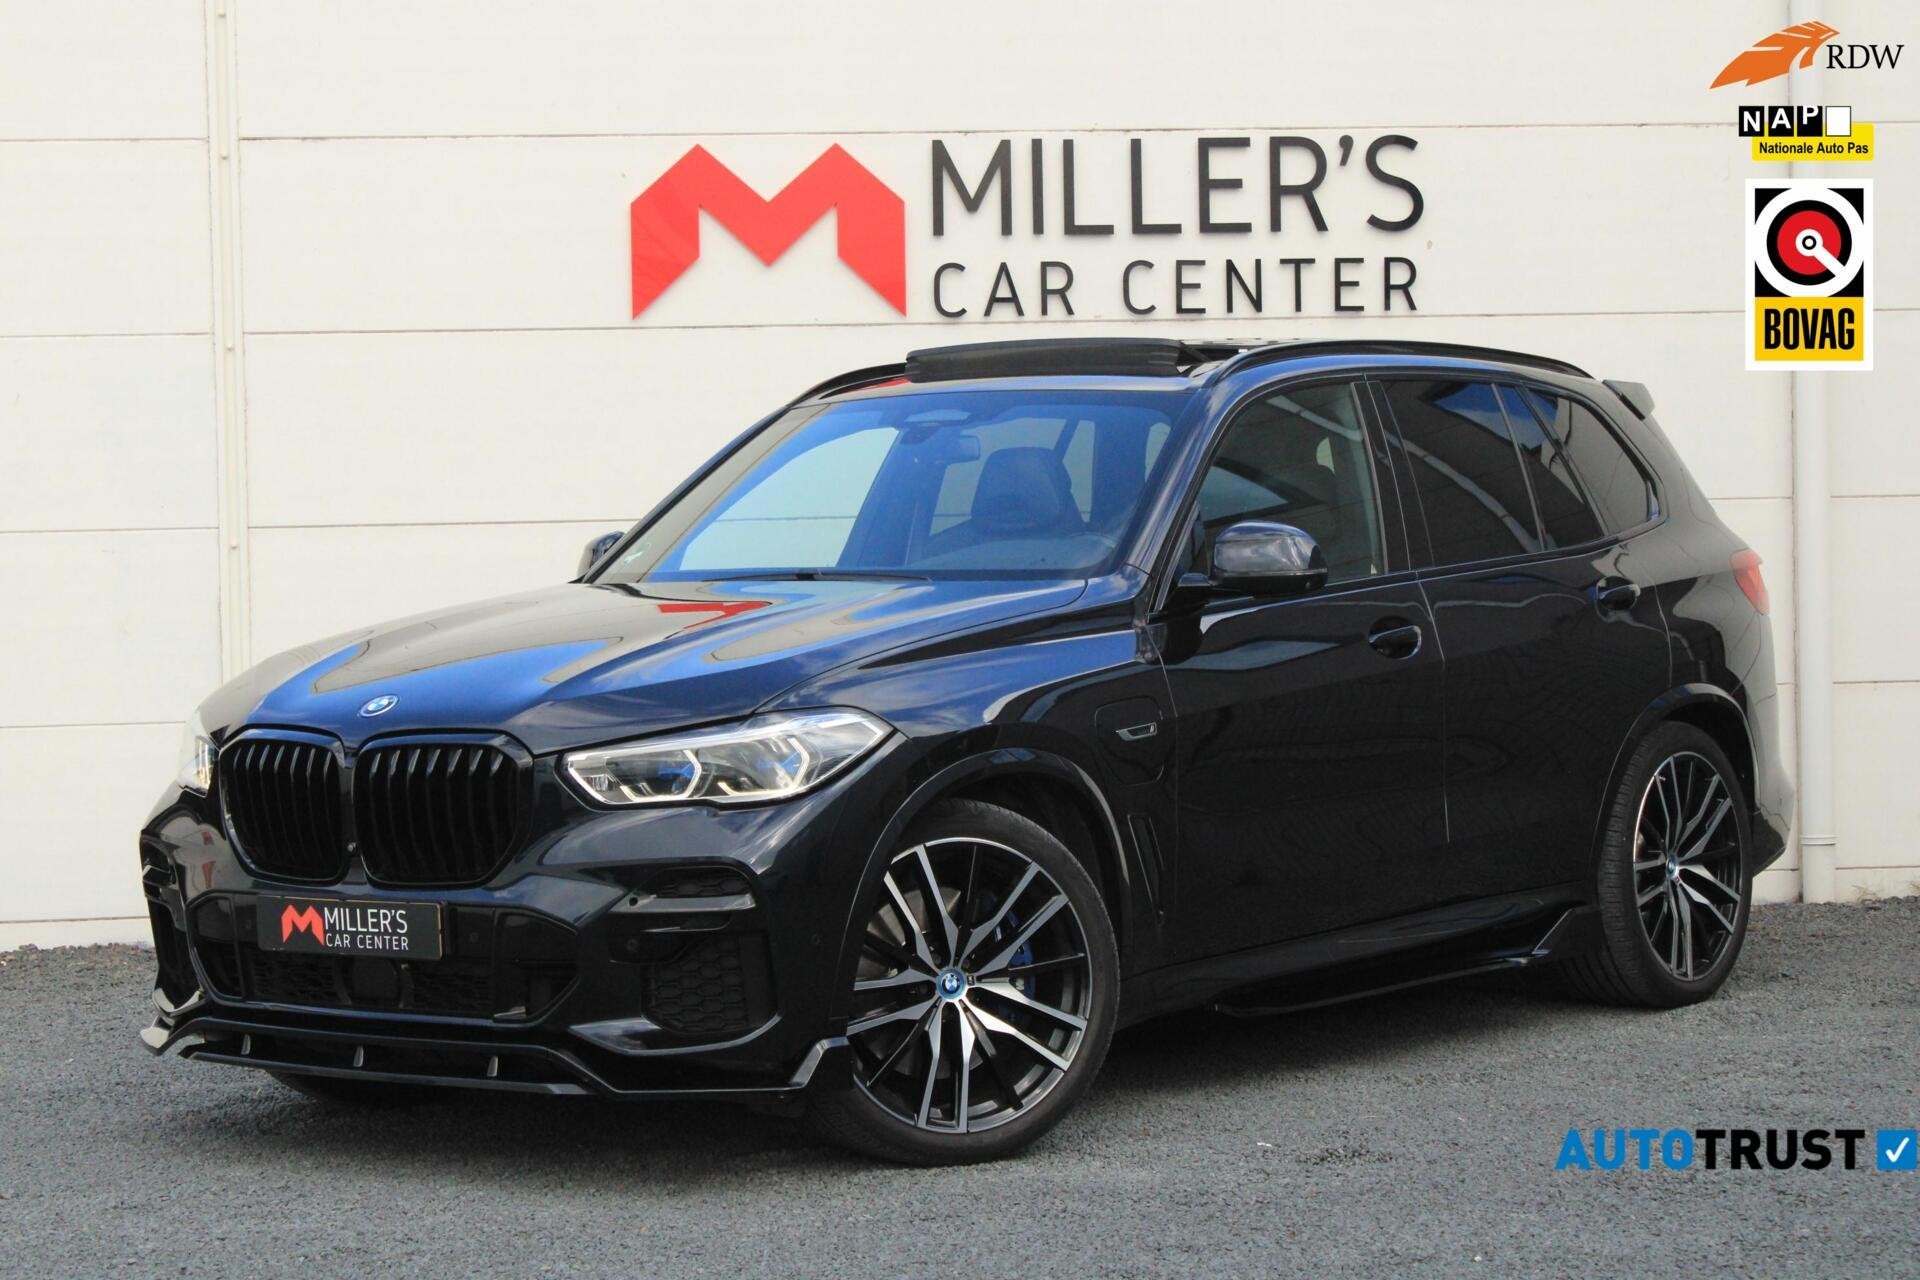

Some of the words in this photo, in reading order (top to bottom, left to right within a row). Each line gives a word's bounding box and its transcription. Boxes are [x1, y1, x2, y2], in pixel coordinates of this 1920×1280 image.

[932, 135, 1424, 236] MILLER'S
[934, 261, 1075, 318] CAR
[1123, 257, 1418, 315] CENTER
[324, 907, 408, 933] MILLER'S
[326, 933, 351, 948] CAR
[357, 935, 409, 950] CENTER
